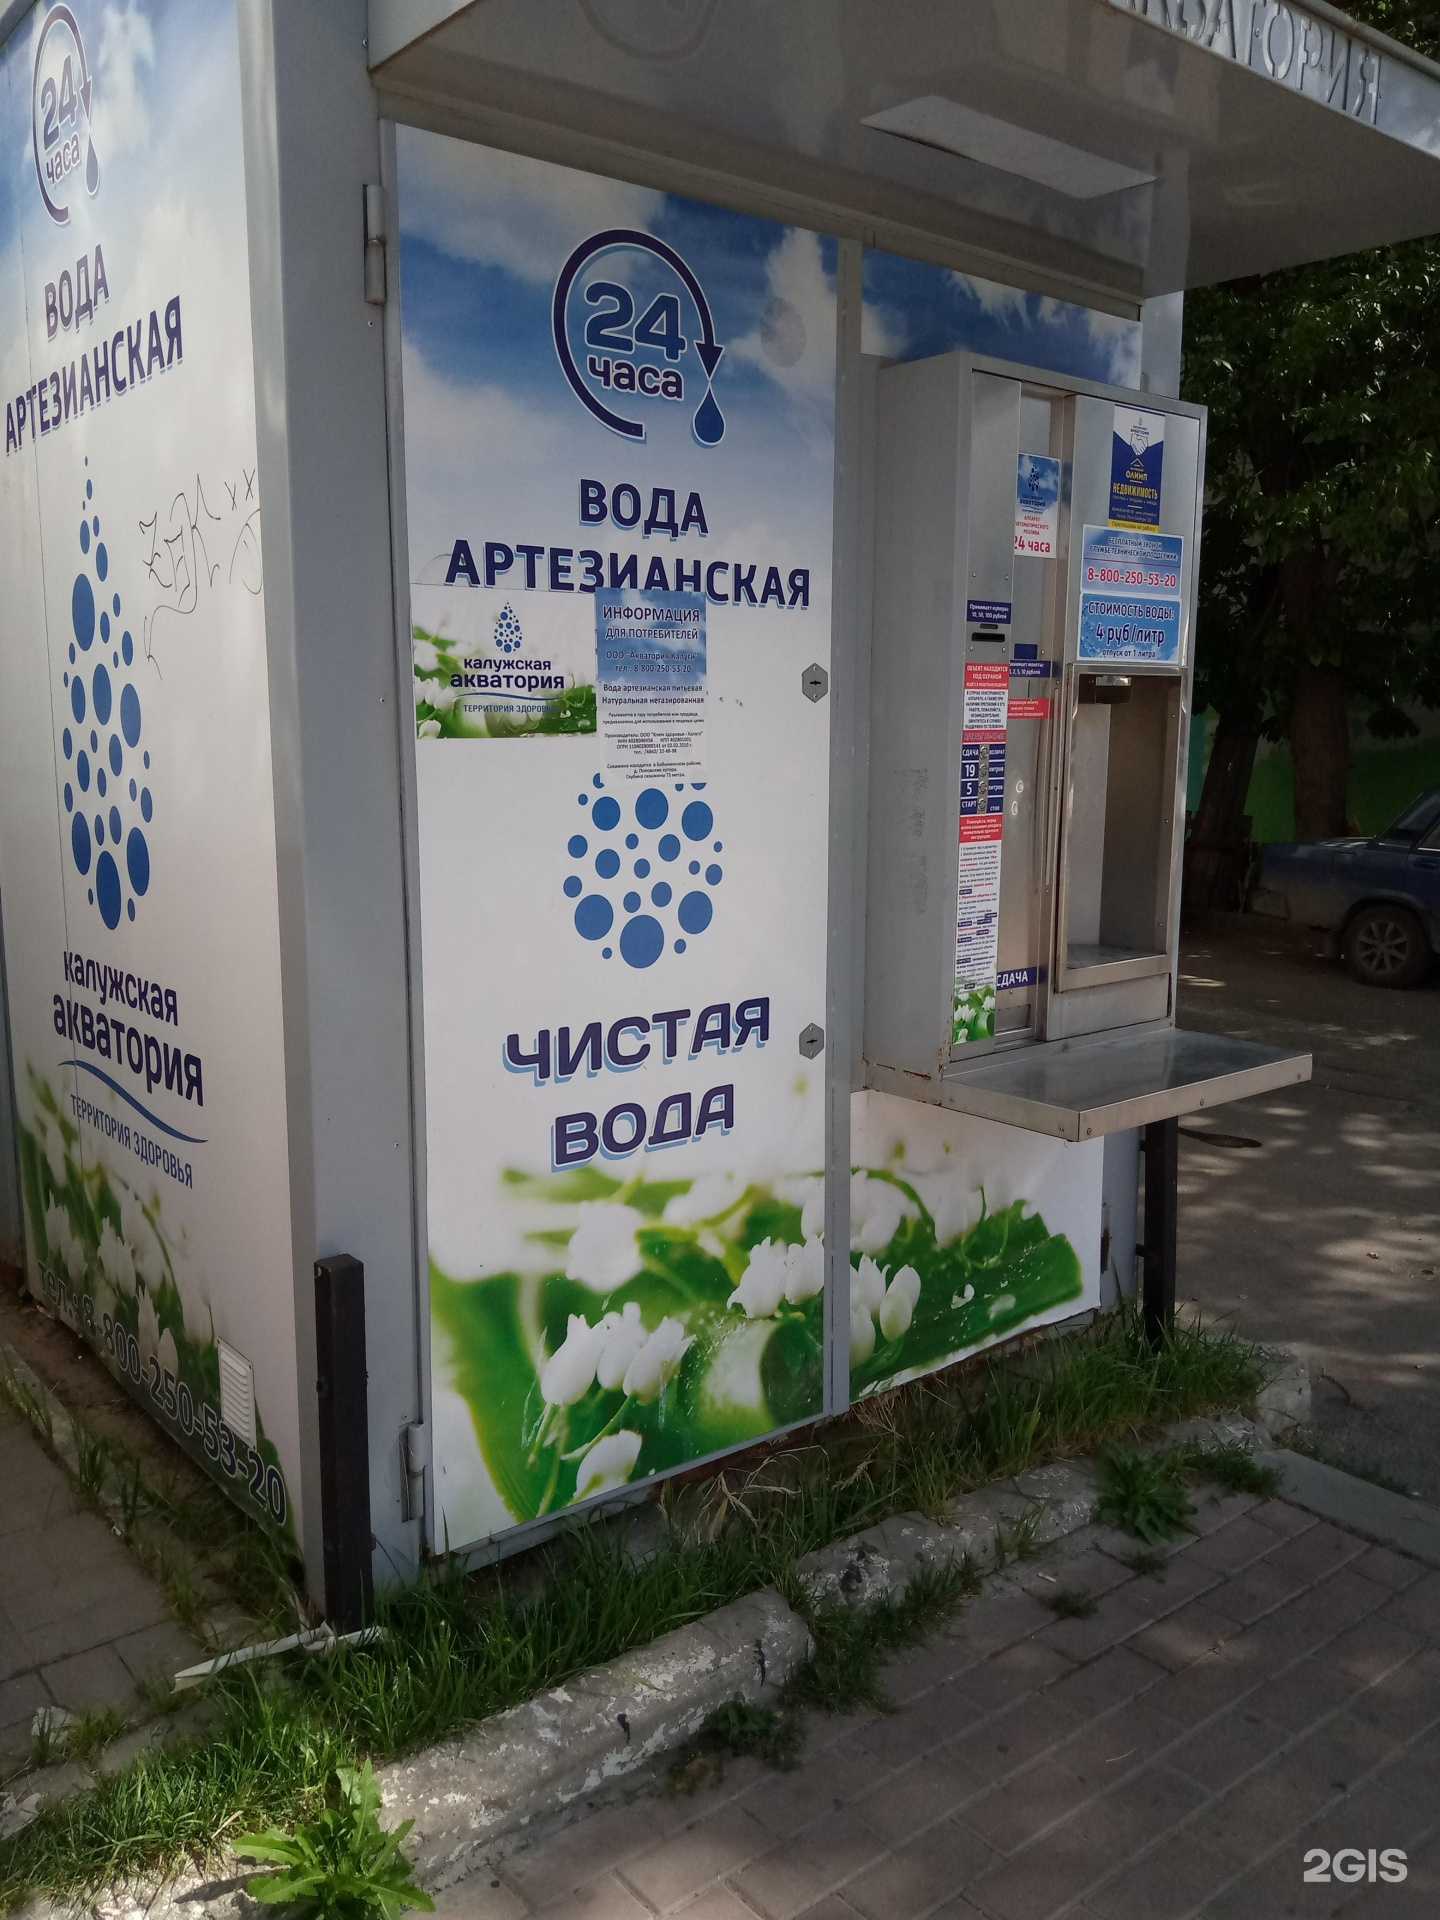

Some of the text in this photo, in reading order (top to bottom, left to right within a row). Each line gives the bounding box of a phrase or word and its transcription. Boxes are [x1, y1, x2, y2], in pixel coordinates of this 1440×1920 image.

[40, 54, 78, 151] 24
[45, 132, 81, 186] часа
[44, 244, 110, 341] ВОДА
[584, 280, 686, 361] 24
[5, 295, 184, 454] АРТЕЗИАНСКАЯ
[587, 354, 685, 400] часа
[1125, 470, 1149, 481] ОЛИМП
[1112, 482, 1159, 500] НЕДВИЖИМОСТЬ
[578, 478, 710, 540] ВОДА
[1028, 541, 1050, 552] часа
[444, 539, 811, 610] АРТЕЗИАНСКАЯ
[1087, 567, 1176, 587] 8-800-250-53-20
[603, 606, 700, 624] ИНФОРМАЦИЯ
[1088, 602, 1174, 619] СТОИМОСТЬ ВОДЫ:
[605, 628, 698, 639] ДЛЯ ПОТРЕБИТЕЛЕЙ
[1096, 624, 1165, 646] 4 руб/литр
[463, 658, 552, 672] калужская
[450, 673, 565, 692] акватория
[603, 684, 621, 693] Вода
[623, 684, 671, 693] артезианская
[463, 704, 514, 713] ТЕРРИТОРИЯ
[602, 696, 705, 706] Натуральная негазированная
[965, 764, 975, 777] 19
[966, 782, 972, 795] 5
[63, 951, 179, 1026] калужская
[997, 970, 1029, 988] СДАЧА
[53, 994, 204, 1106] акватория
[503, 996, 771, 1085] ЧИСТАЯ
[552, 1083, 735, 1170] ВОДА
[70, 1094, 194, 1190] ТЕРРИТОРИЯ ЗДОРОВЬЯ
